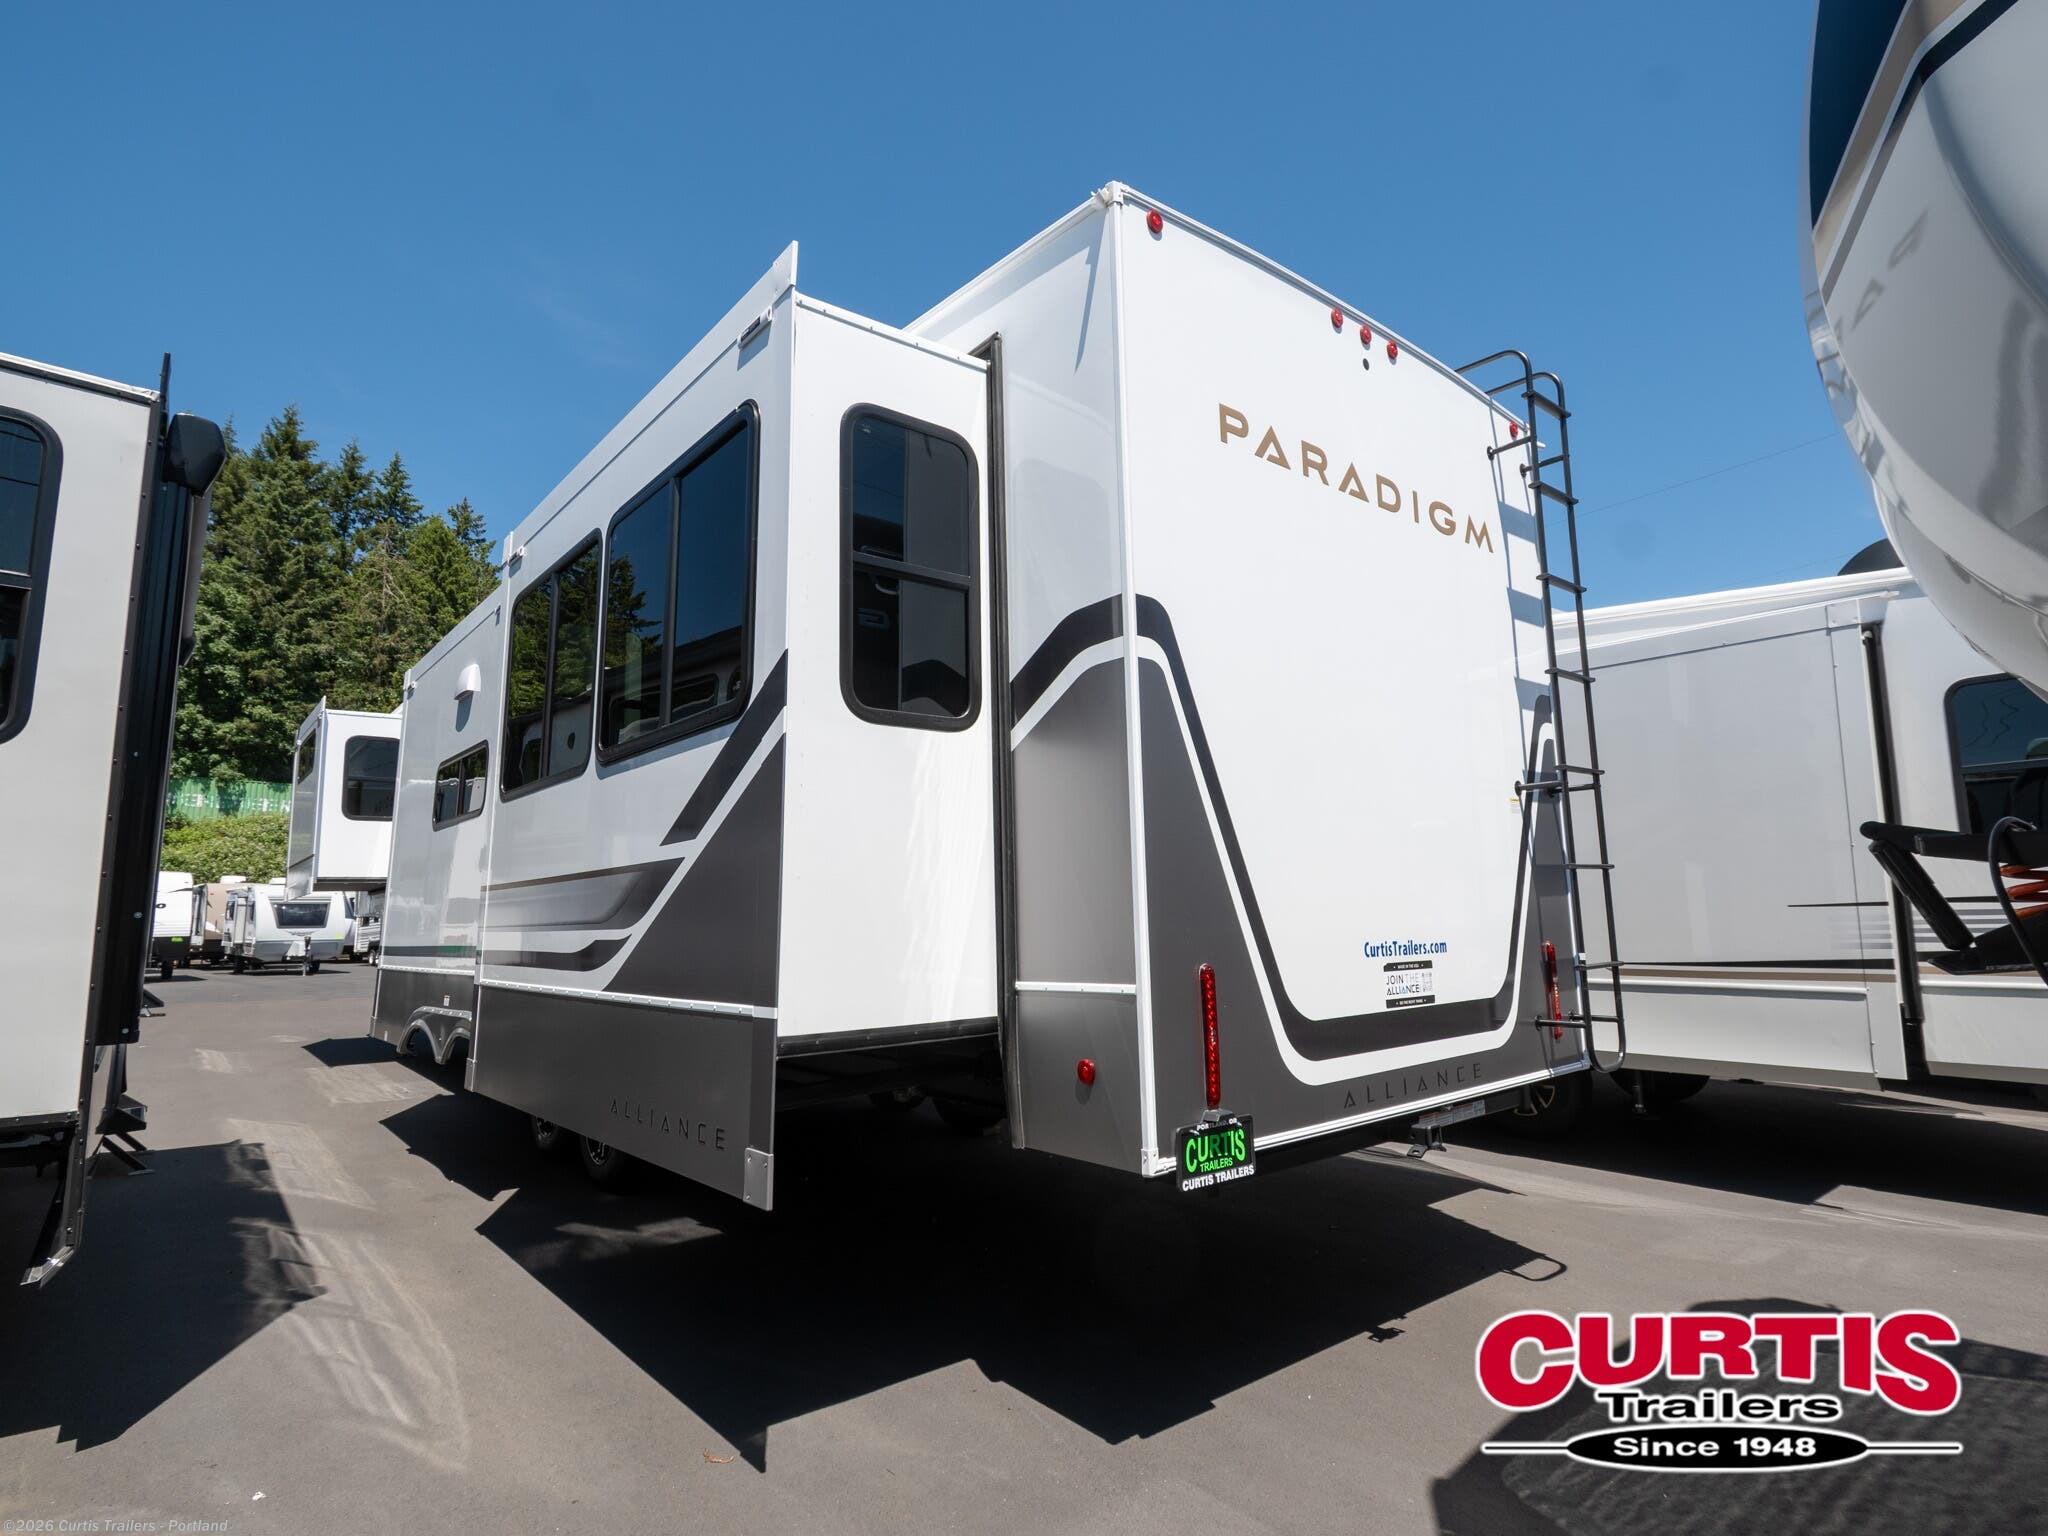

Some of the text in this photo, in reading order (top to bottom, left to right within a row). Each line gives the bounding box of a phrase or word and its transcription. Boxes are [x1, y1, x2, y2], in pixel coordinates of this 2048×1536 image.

[1218, 402, 1494, 554] PARADIGM
[1363, 940, 1448, 958] CurtisTrailers.com
[1386, 974, 1404, 985] JOIN
[1386, 984, 1420, 996] ALLIANCE
[1343, 1062, 1483, 1109] ALLIANCE
[609, 1098, 726, 1150] ALLIANCE
[1185, 1128, 1246, 1173] CURTIS
[1182, 1164, 1255, 1192] CURTIS TRAILERS
[1200, 1157, 1233, 1173] TRAILERS
